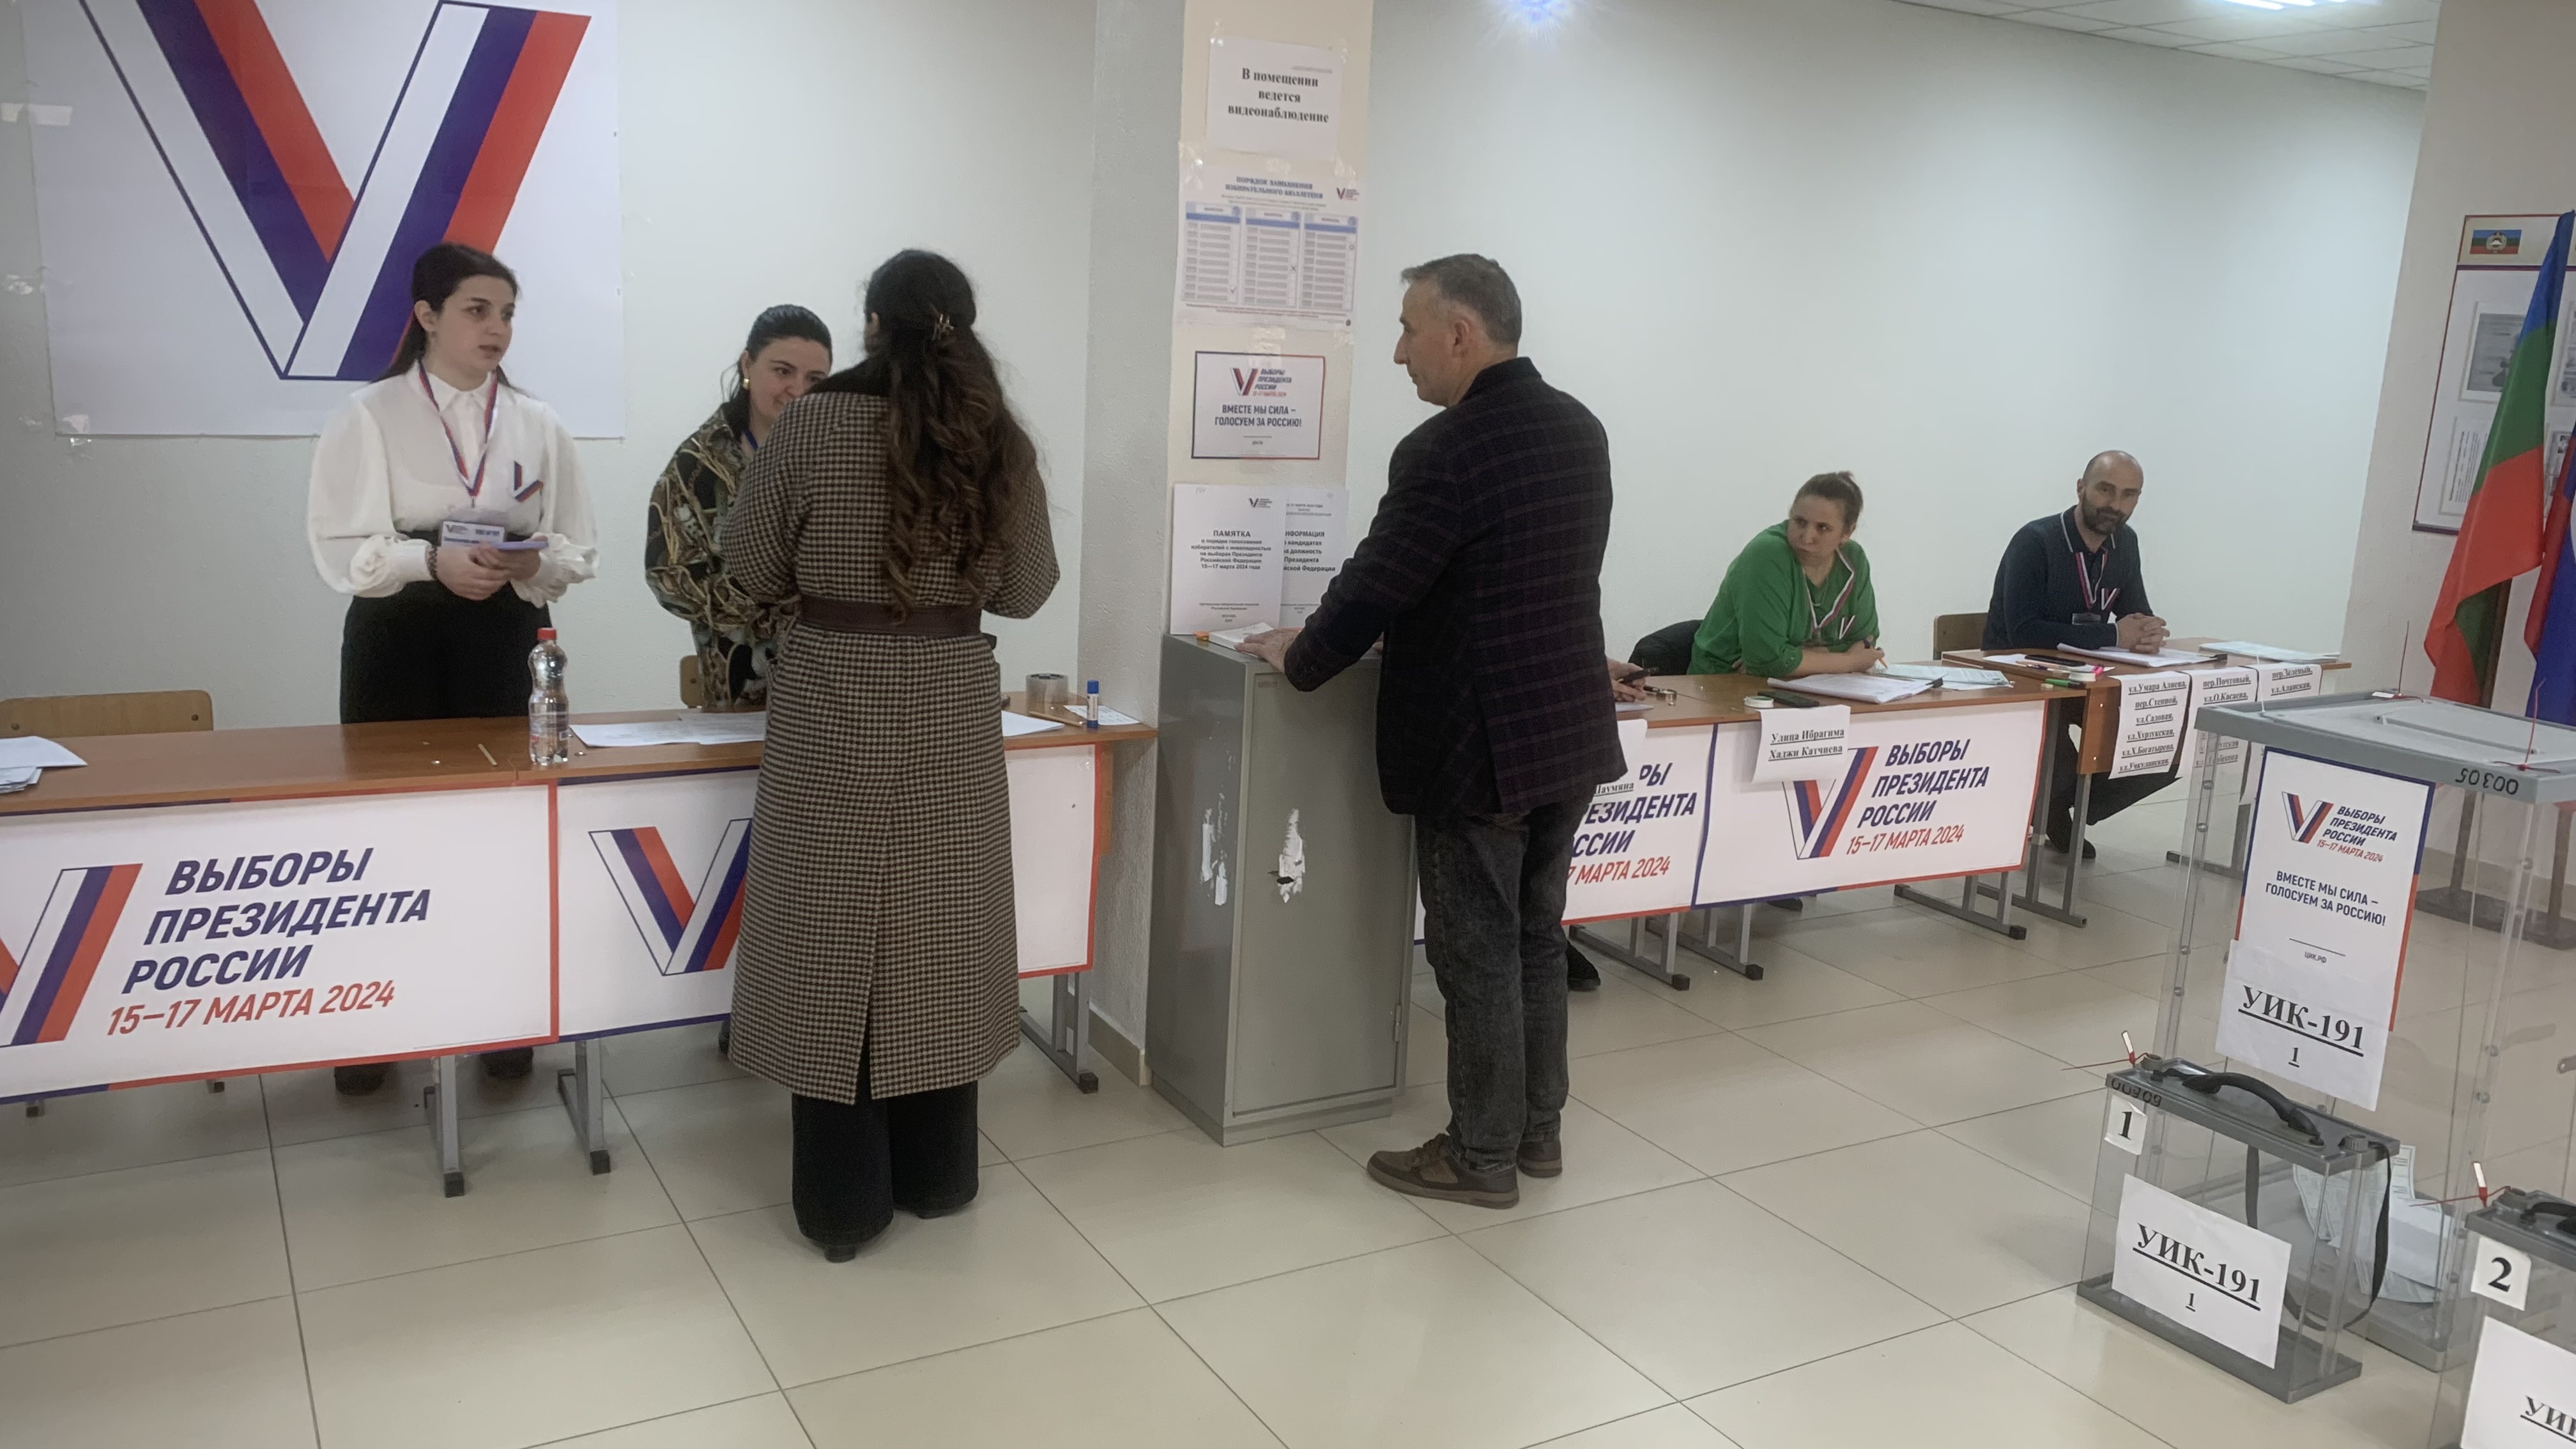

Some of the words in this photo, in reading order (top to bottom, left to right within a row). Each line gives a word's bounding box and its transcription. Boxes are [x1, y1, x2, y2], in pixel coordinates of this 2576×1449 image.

[1242, 68, 1250, 80] В
[1254, 71, 1319, 87] помещении
[1258, 90, 1301, 103] ведется
[1227, 105, 1329, 123] видеонаблюдение
[1215, 417, 1255, 426] ГОЛОСУЕМ
[1256, 417, 1265, 426] ЗА
[1267, 417, 1302, 427] РОССИЮ!
[1222, 404, 1252, 414] ВМЕСТЕ
[1254, 405, 1266, 414] МЫ
[1268, 405, 1289, 415] СИЛА
[1771, 732, 1799, 745] Улица
[1801, 727, 1844, 742] Ибрагима
[1768, 747, 1799, 760] Хаджи
[1885, 739, 1971, 767] ВЫБОРЫ
[1871, 766, 1989, 798] ПРЕЗИДЕНТА
[1584, 792, 1698, 825] ЕЗИДЕНТА
[1857, 800, 1937, 828] РОССИИ
[2337, 806, 2386, 825] ВЫБОРЫ
[1885, 827, 1932, 850] МАРТА
[1932, 824, 1965, 845] 2024
[2322, 829, 2366, 847] РОССИИ
[2330, 817, 2398, 841] ПРЕЗИДЕНТА
[1572, 830, 1636, 858] ССИИ
[2338, 845, 2364, 858] МАРТА
[2364, 851, 2384, 862] 2024
[165, 847, 374, 895] ВЫБОРЫ
[1574, 860, 1631, 885] МАРТА
[1631, 856, 1671, 879] 2024
[2276, 871, 2316, 891] ВМЕСТЕ
[2319, 882, 2337, 896] МЫ
[2340, 888, 2368, 905] СИЛА
[142, 889, 432, 946] ПРЕЗИДЕНТА
[2266, 883, 2319, 907] ГОЛОСУЕМ
[2320, 898, 2333, 912] ЗА
[2336, 903, 2386, 926] РОССИЮ!
[121, 944, 314, 995] РОССИИ
[2304, 951, 2327, 963] ЦИК.РФ
[203, 988, 314, 1026] МАРТА
[318, 979, 396, 1015] 2024
[2242, 984, 2364, 1050] УИК-191
[2291, 1047, 2300, 1065] 1
[2119, 1110, 2133, 1140] 1
[2136, 1222, 2262, 1305] УИК-191
[2488, 1257, 2512, 1292] 2
[2188, 1292, 2196, 1308] 1
